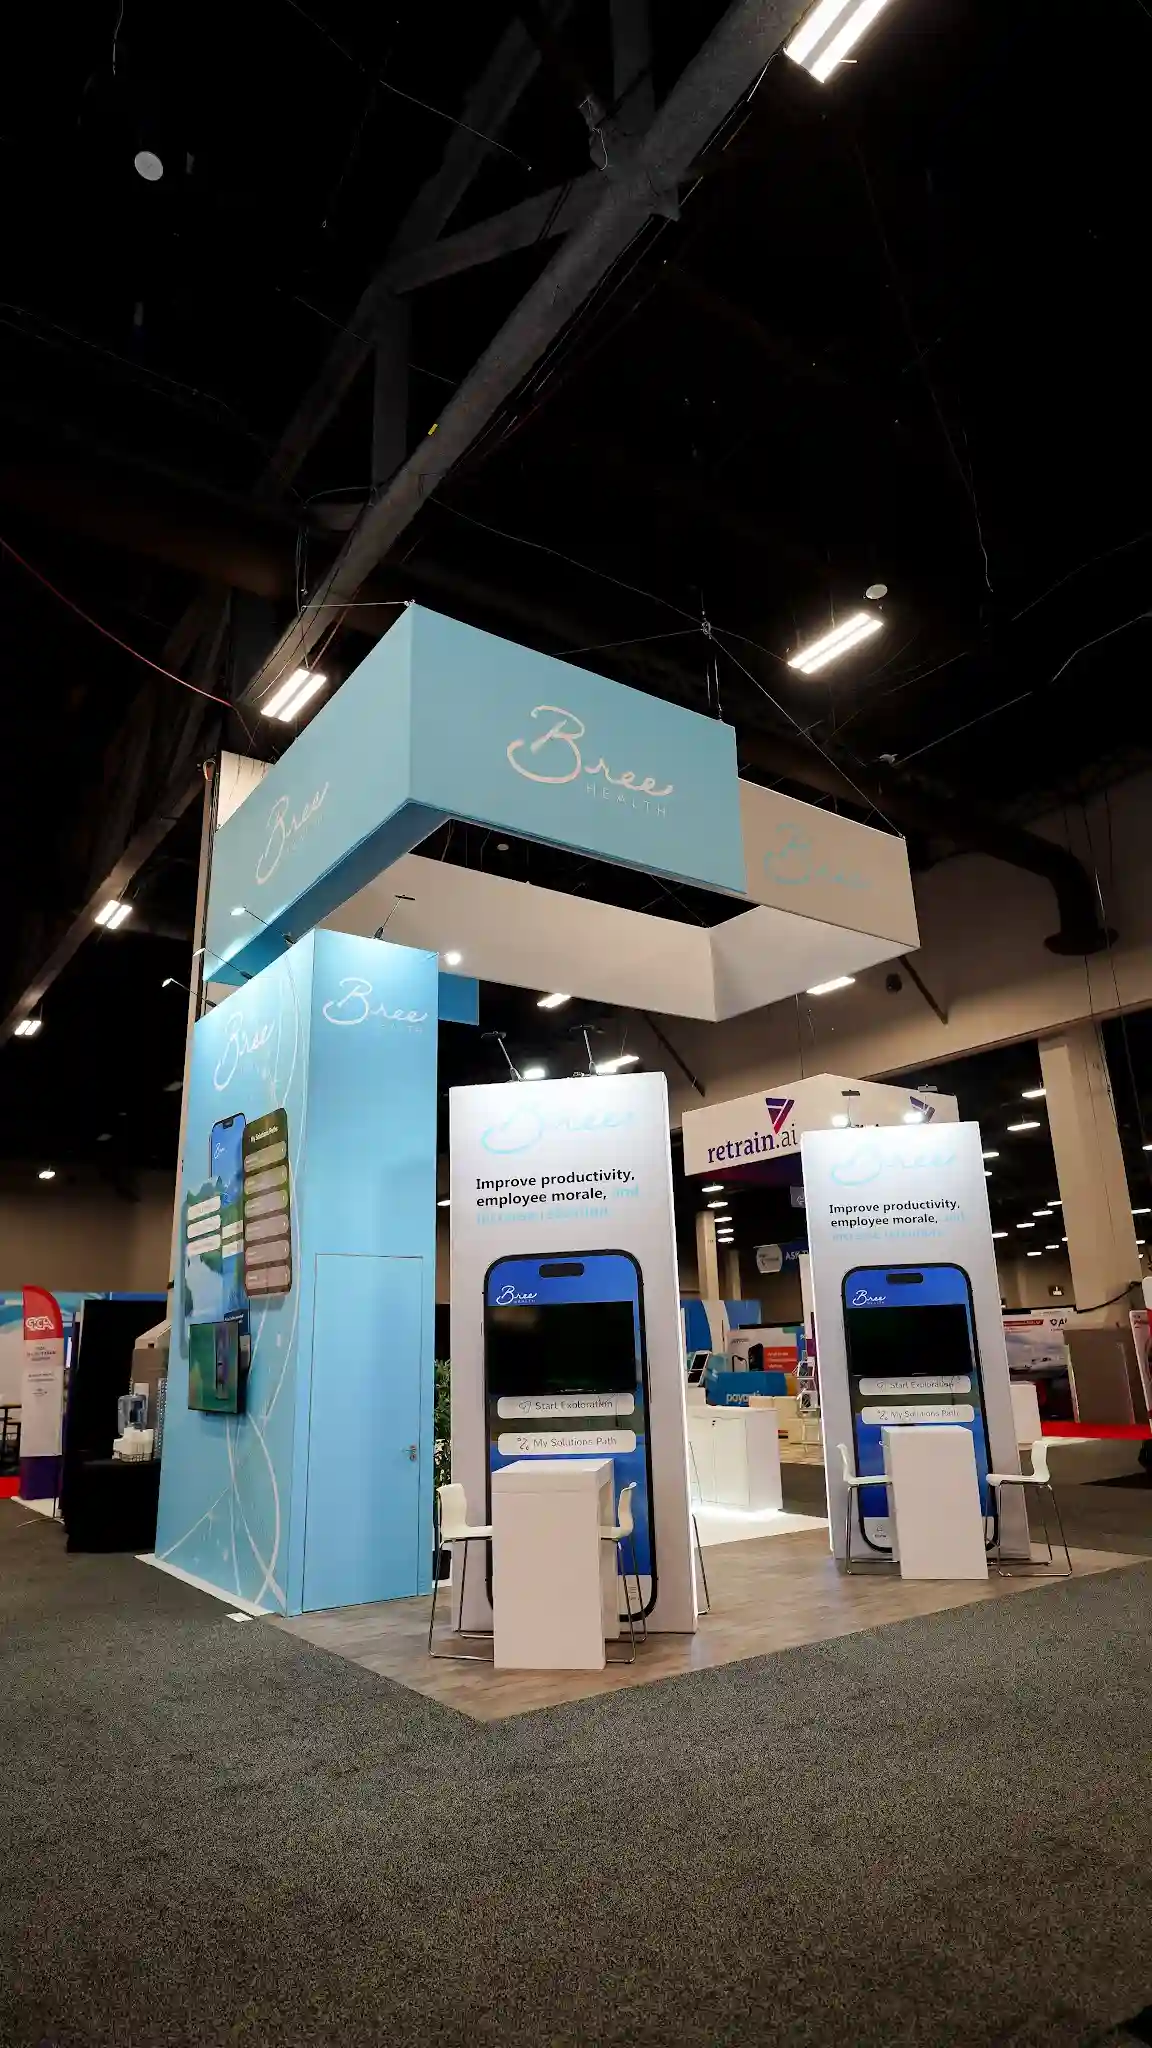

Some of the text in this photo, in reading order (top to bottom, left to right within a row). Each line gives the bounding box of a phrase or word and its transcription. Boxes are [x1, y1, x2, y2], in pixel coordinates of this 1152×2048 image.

[506, 705, 674, 796] Bree
[322, 977, 428, 1025] Bree
[707, 1123, 797, 1164] retrain.ai
[476, 1177, 537, 1192] Improve
[476, 1193, 547, 1208] employee
[551, 1187, 607, 1202] morale,
[829, 1204, 880, 1218] Improve
[831, 1217, 890, 1229] employee
[496, 1285, 538, 1305] Bree
[852, 1289, 887, 1306] Bree
[535, 1401, 559, 1411] Start
[533, 1439, 547, 1448] My
